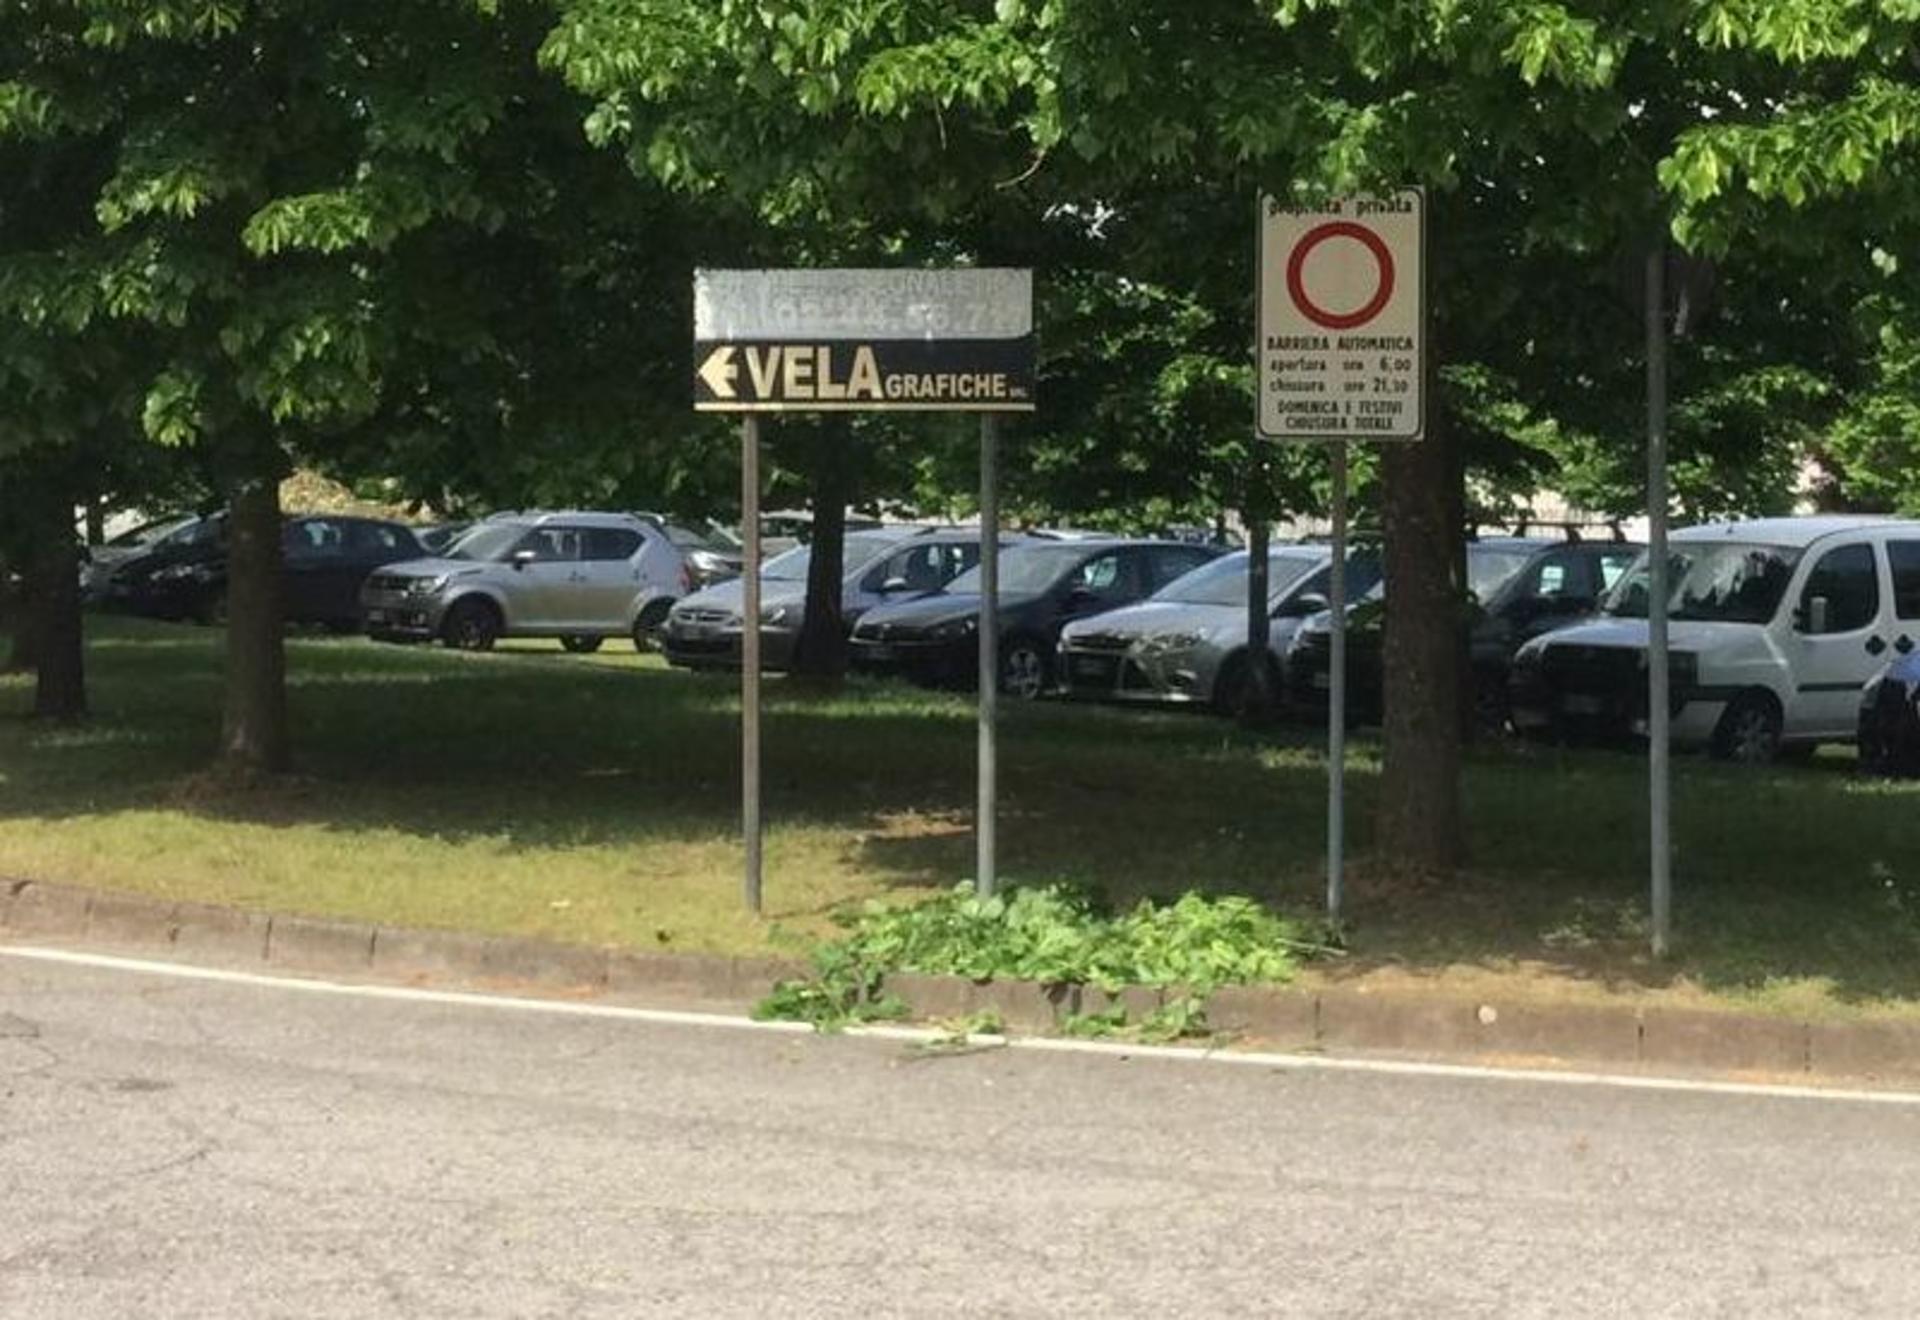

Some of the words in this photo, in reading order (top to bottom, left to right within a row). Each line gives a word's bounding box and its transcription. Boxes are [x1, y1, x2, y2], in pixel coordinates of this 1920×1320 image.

[1267, 335, 1330, 350] BARRIERA
[1337, 335, 1414, 350] AUTOMATICA
[745, 345, 883, 399] VELA
[885, 373, 1007, 398] GRAFICHE
[1270, 357, 1326, 373] apertura
[1343, 360, 1364, 371] ore
[1269, 377, 1325, 392] chiusura
[1343, 380, 1365, 392] ore
[1278, 400, 1339, 414] DOMENICA
[1345, 401, 1351, 414] E
[1359, 401, 1403, 415] FESTIVI
[1285, 416, 1347, 430] CHIUSURA
[1354, 416, 1393, 430] TOTALE
